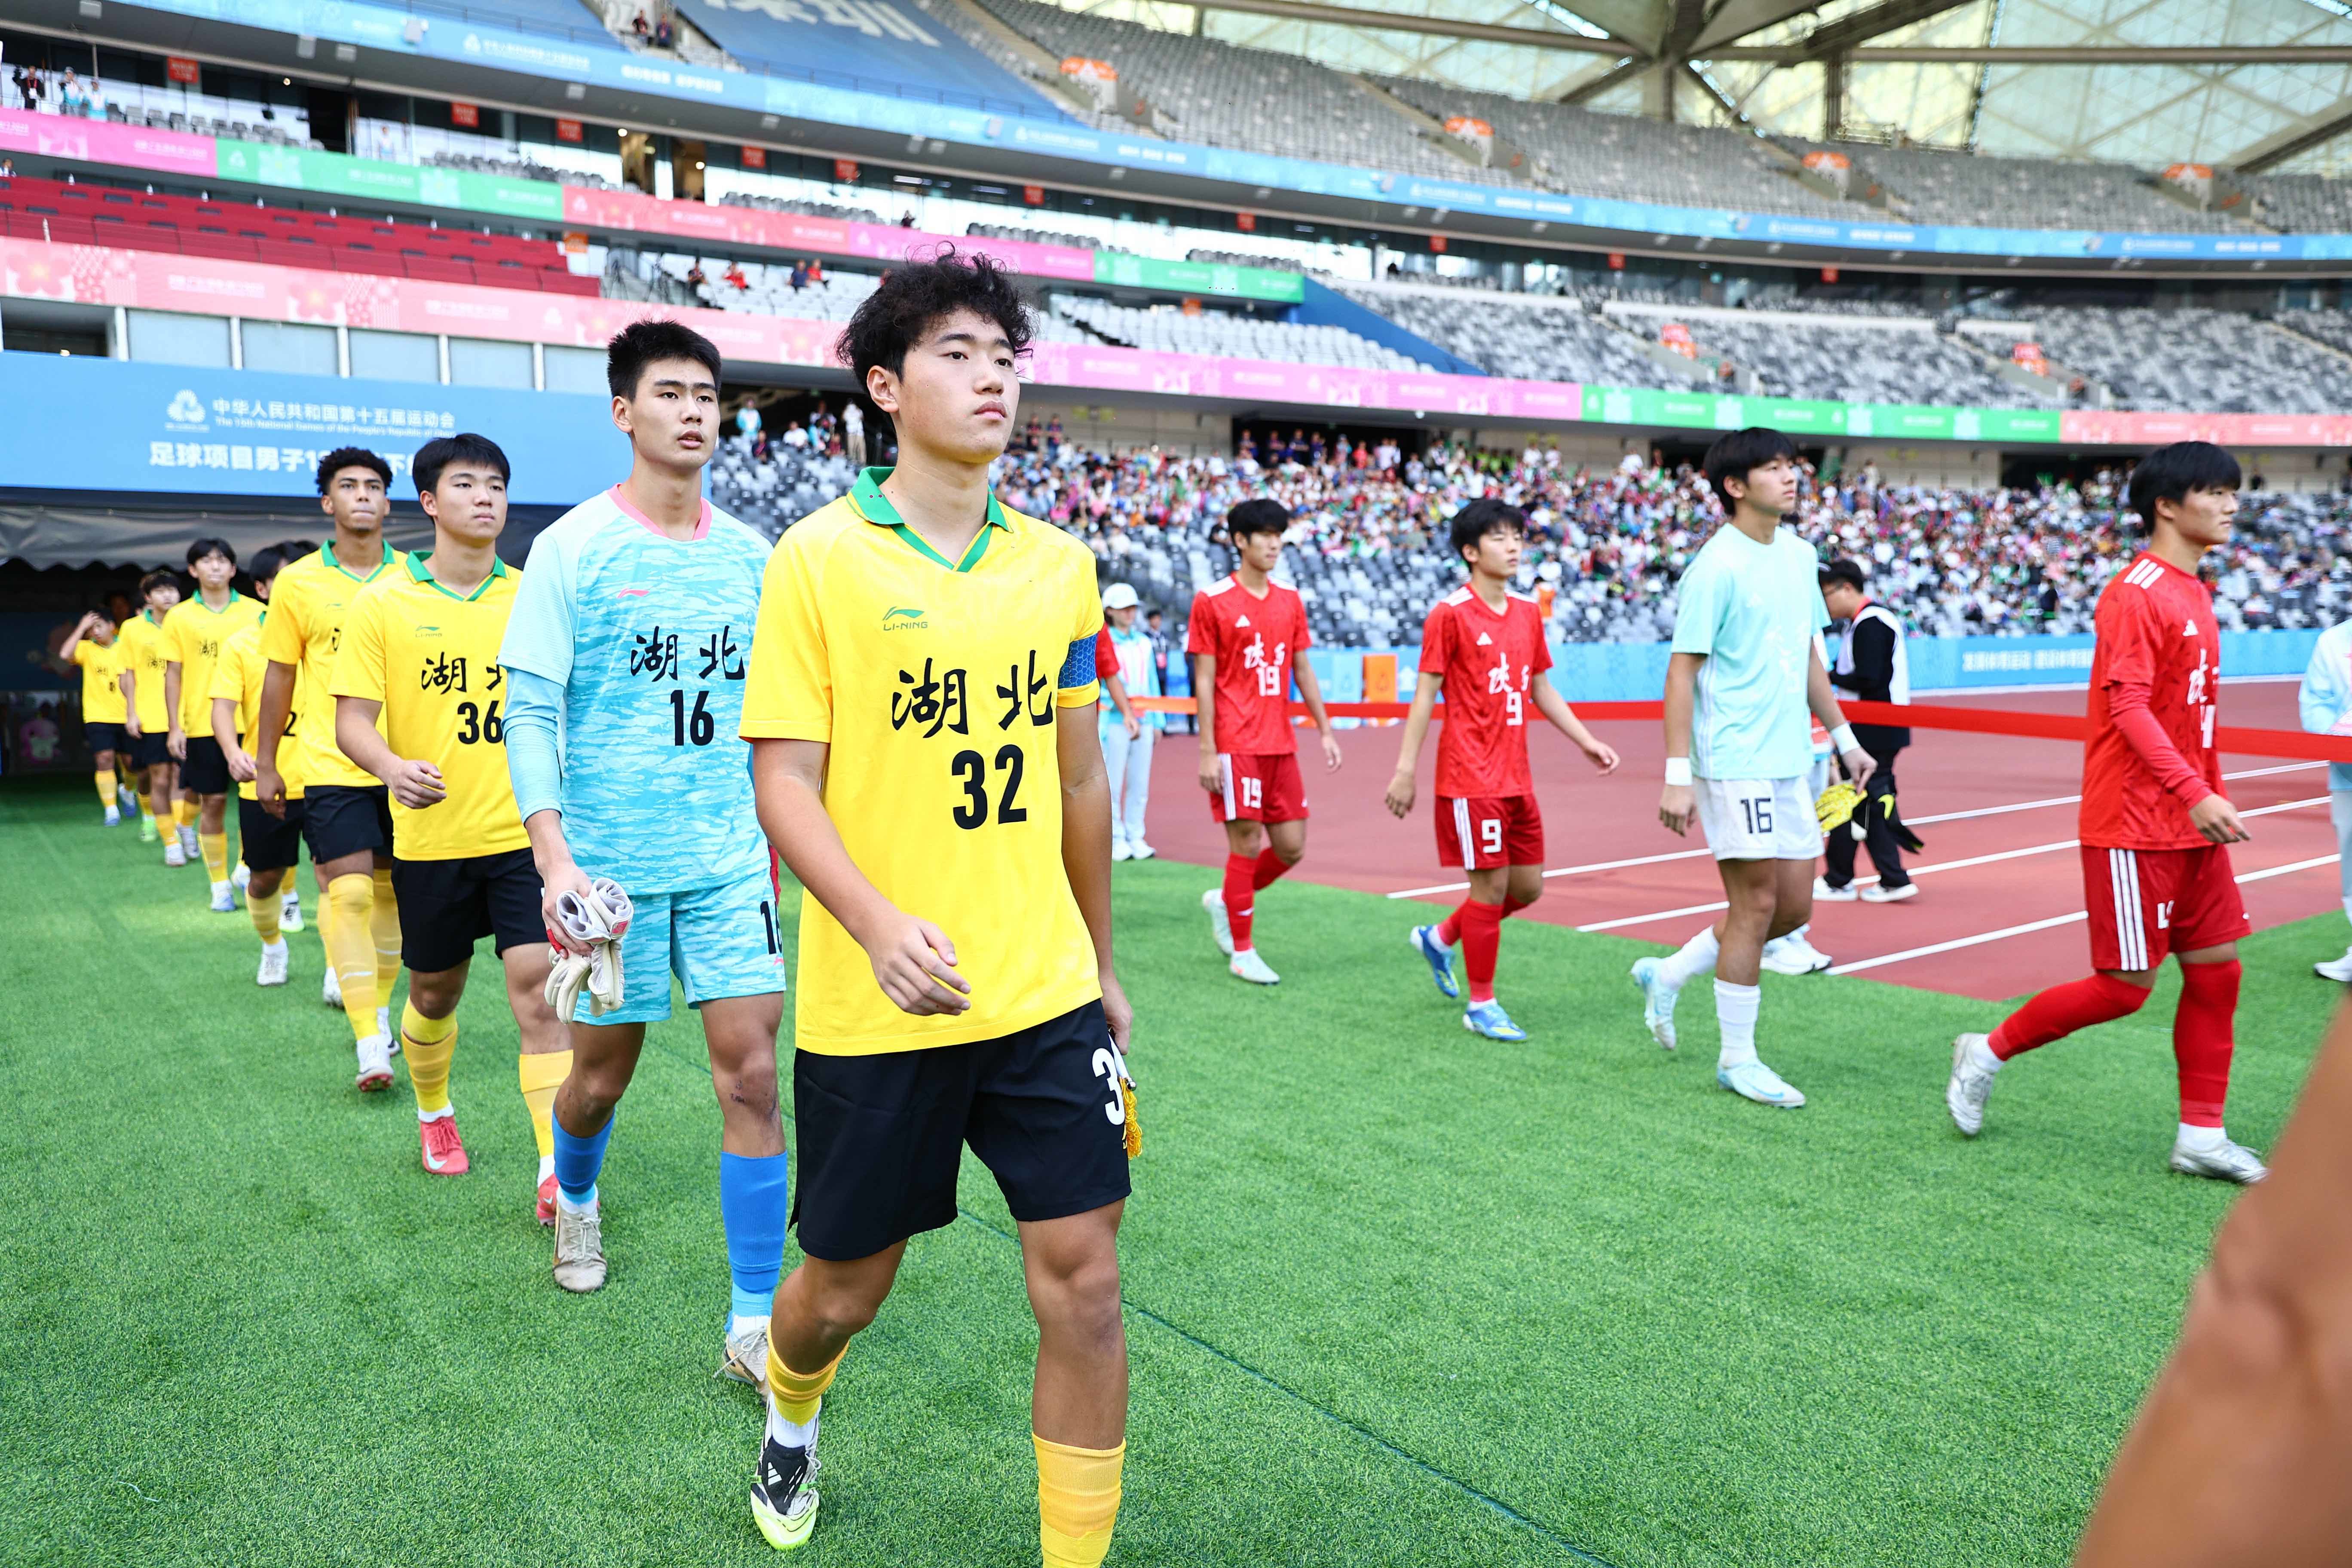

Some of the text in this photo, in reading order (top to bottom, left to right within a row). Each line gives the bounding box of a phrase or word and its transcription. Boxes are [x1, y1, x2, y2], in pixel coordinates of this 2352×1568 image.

[212, 397, 455, 429] 中华人民共和国第十五届运动会
[215, 416, 233, 427] The
[257, 420, 294, 431] National
[295, 423, 324, 432] Games
[326, 424, 336, 432] of
[352, 426, 386, 436] People's
[388, 427, 422, 438] Republic
[883, 621, 928, 631] LI-NING
[630, 625, 745, 682] 湖北
[891, 649, 1054, 738] 湖北
[1256, 665, 1281, 697] 19
[457, 701, 504, 744] 36
[670, 689, 714, 747] 16
[1506, 691, 1523, 726] 9
[951, 744, 1027, 830] 32
[1240, 777, 1262, 809] 19
[1740, 798, 1772, 834] 16
[1481, 818, 1502, 854] 9
